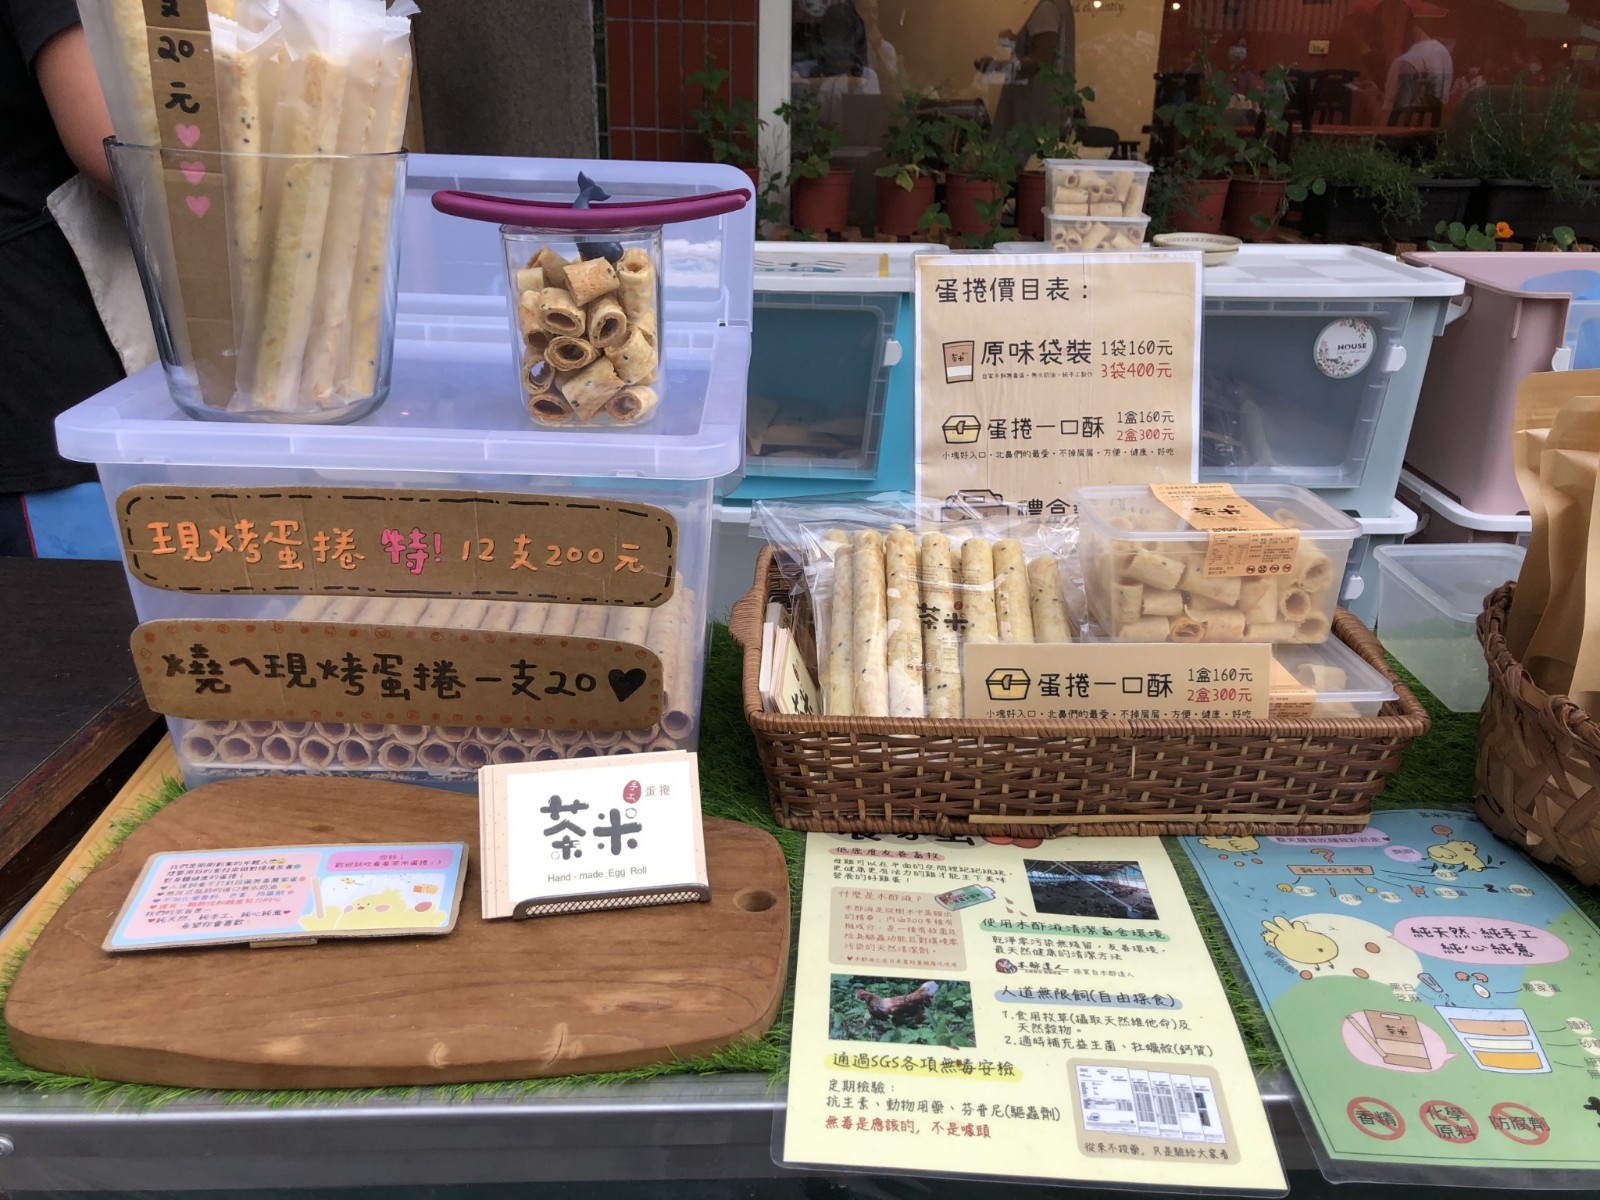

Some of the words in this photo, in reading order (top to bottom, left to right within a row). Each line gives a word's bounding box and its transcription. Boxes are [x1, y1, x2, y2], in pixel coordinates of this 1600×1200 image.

[935, 277, 1088, 303] 蛋捲價目表：
[981, 339, 1092, 366] 原味袋裝
[1101, 339, 1173, 357] 1袋160元
[1101, 362, 1173, 380] 3袋400元
[1117, 411, 1175, 425] 1盒160元
[987, 416, 1105, 439] 蛋捲一口酥
[1116, 428, 1175, 442] 2盒300元
[147, 519, 365, 571] 現烤蛋捲
[917, 602, 969, 632] 茶米
[1187, 667, 1253, 683] 1盒160元
[1038, 672, 1173, 698] 蛋捲一口酥
[1186, 687, 1253, 703] 2盒300元
[646, 784, 670, 797] 蛋捲
[540, 795, 643, 860] 茶米
[547, 873, 572, 883] Hand
[579, 870, 604, 880] made
[608, 868, 626, 879] Egg
[630, 866, 648, 876] Roll
[1441, 941, 1536, 958] 純心純意
[833, 1052, 1016, 1077] 通過SGS各項無毒安檢
[1426, 1106, 1467, 1121] 化學
[1434, 1124, 1477, 1140] 原料
[1488, 1116, 1550, 1132] 防腐劑
